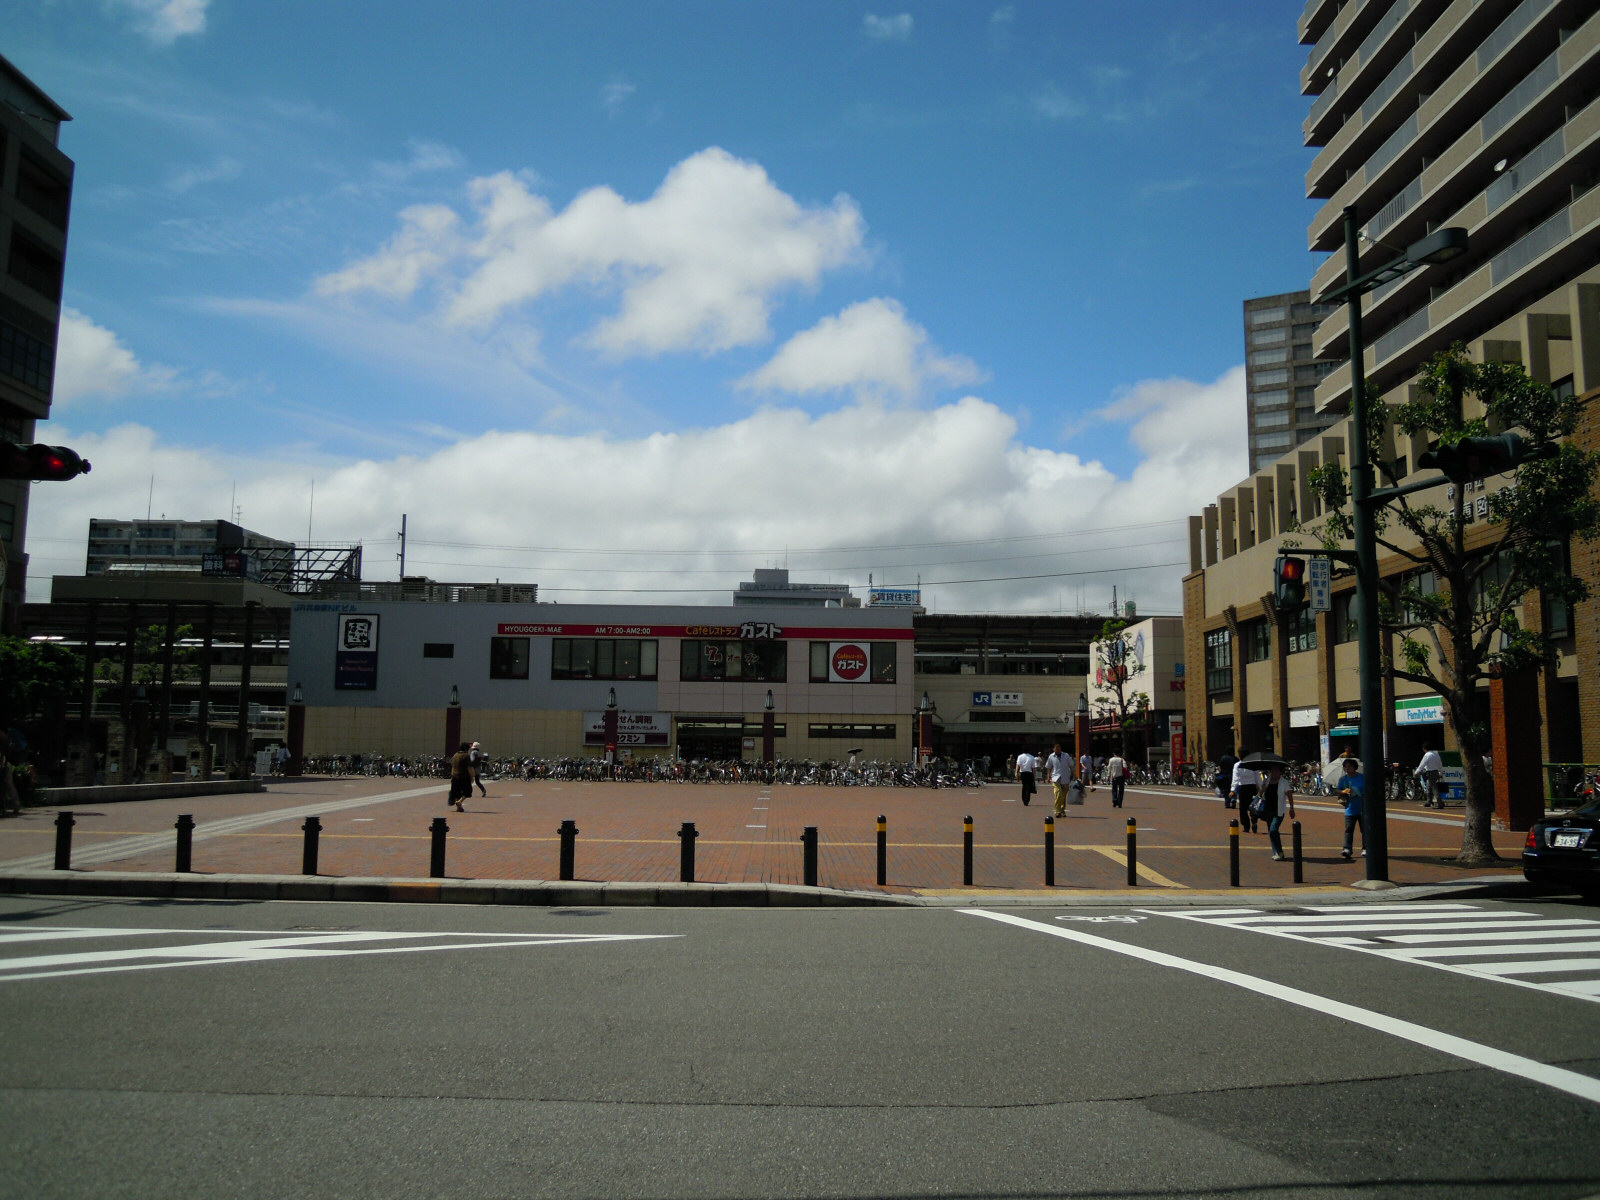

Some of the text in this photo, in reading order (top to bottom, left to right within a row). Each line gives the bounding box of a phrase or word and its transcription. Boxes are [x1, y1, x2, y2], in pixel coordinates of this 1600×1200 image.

[1312, 562, 1320, 588] 自転車
[1320, 562, 1328, 588] 歩行者
[878, 592, 912, 602] 賃貸住宅
[1317, 589, 1325, 607] 専用
[504, 625, 562, 633] HYOUGOEKI-MAE
[740, 622, 782, 639] ガスト
[837, 659, 864, 670] ガスト
[975, 694, 990, 703] JR
[1407, 709, 1437, 721] FamilyMart
[1442, 770, 1464, 779] Family
